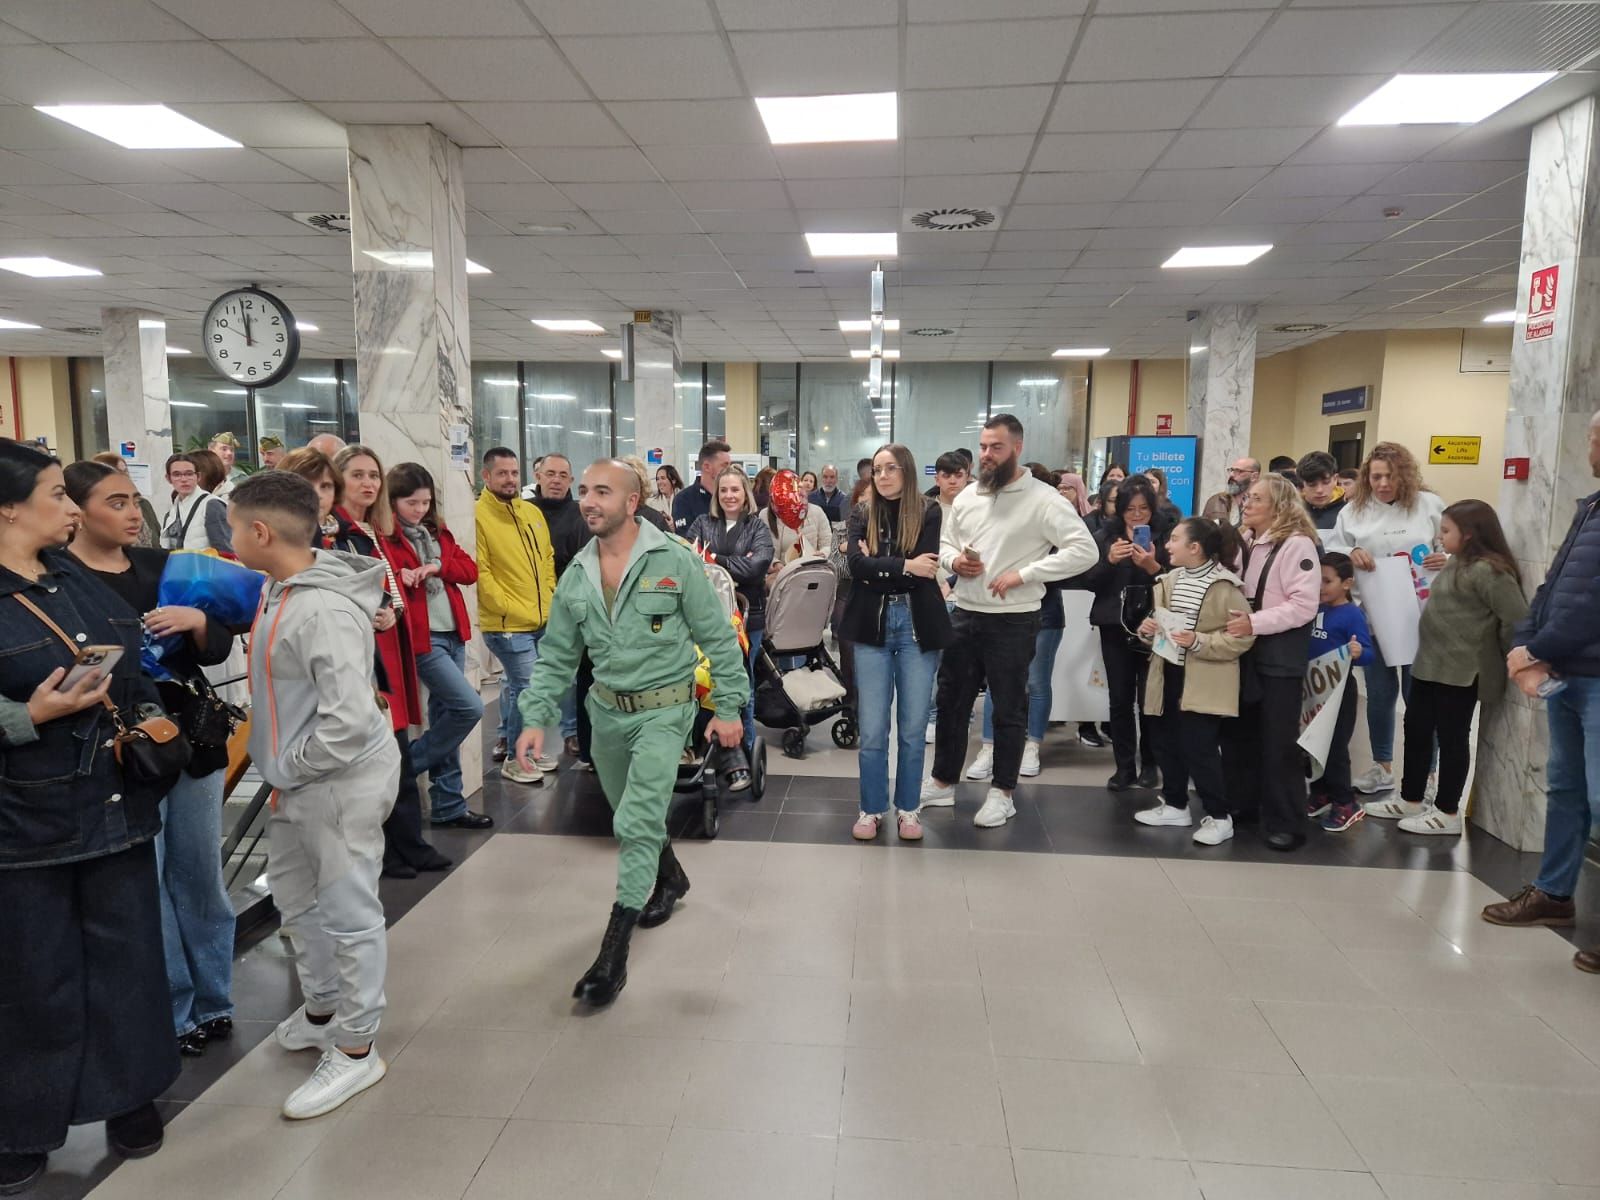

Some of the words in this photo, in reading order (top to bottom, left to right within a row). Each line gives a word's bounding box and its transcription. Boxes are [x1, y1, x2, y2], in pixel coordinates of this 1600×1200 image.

[226, 306, 236, 315] 11
[216, 319, 228, 328] 10
[271, 316, 280, 325] 2
[213, 334, 223, 343] 9
[275, 333, 284, 342] 3
[219, 349, 229, 358] 8
[272, 349, 281, 357] 4
[232, 361, 242, 370] 7
[263, 361, 273, 370] 5
[247, 366, 257, 375] 6
[1136, 452, 1149, 461] Tu
[1152, 452, 1185, 461] billete
